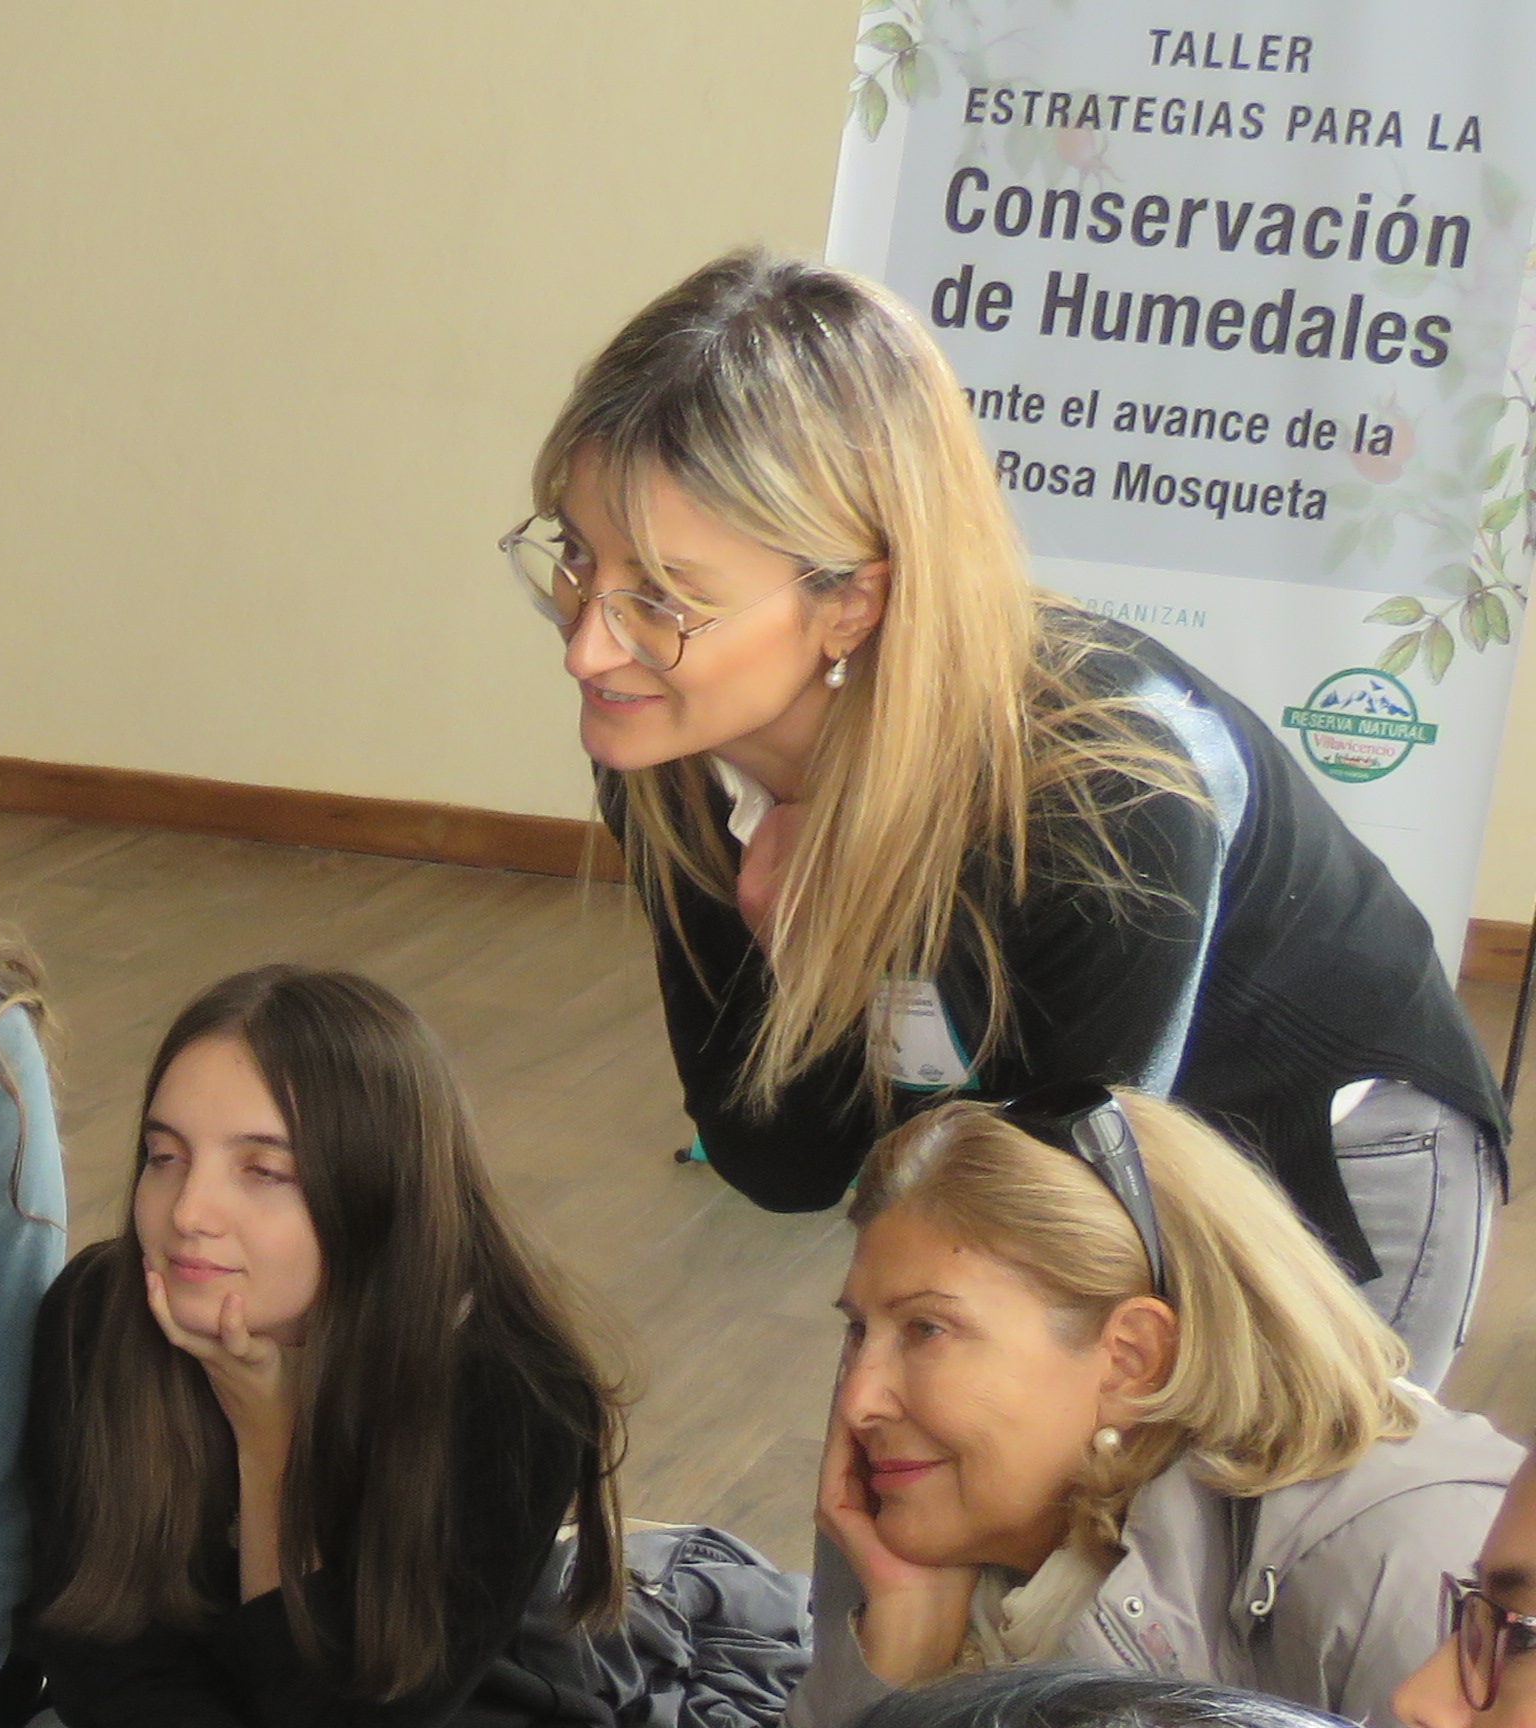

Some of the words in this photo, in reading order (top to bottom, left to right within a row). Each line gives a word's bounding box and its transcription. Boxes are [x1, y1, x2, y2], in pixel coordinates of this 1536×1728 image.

[1149, 29, 1313, 74] TALLER
[963, 87, 1266, 141] ESTRATEGIAS
[1286, 105, 1403, 149] PARA
[1427, 113, 1483, 154] LA
[944, 166, 1471, 269] Conservación
[931, 264, 1014, 332] de
[1039, 270, 1453, 369] Humedales
[1060, 389, 1100, 429] el
[1113, 400, 1270, 444] avance
[1285, 408, 1338, 452] de
[1352, 413, 1395, 457] la
[995, 449, 1097, 498] Rosa
[1112, 461, 1328, 521] Mosqueta
[1072, 596, 1207, 629] RGANIZAN
[1291, 710, 1353, 732] RESERVA
[1358, 719, 1428, 741] NATURAL
[1314, 733, 1396, 757] Villavicencio
